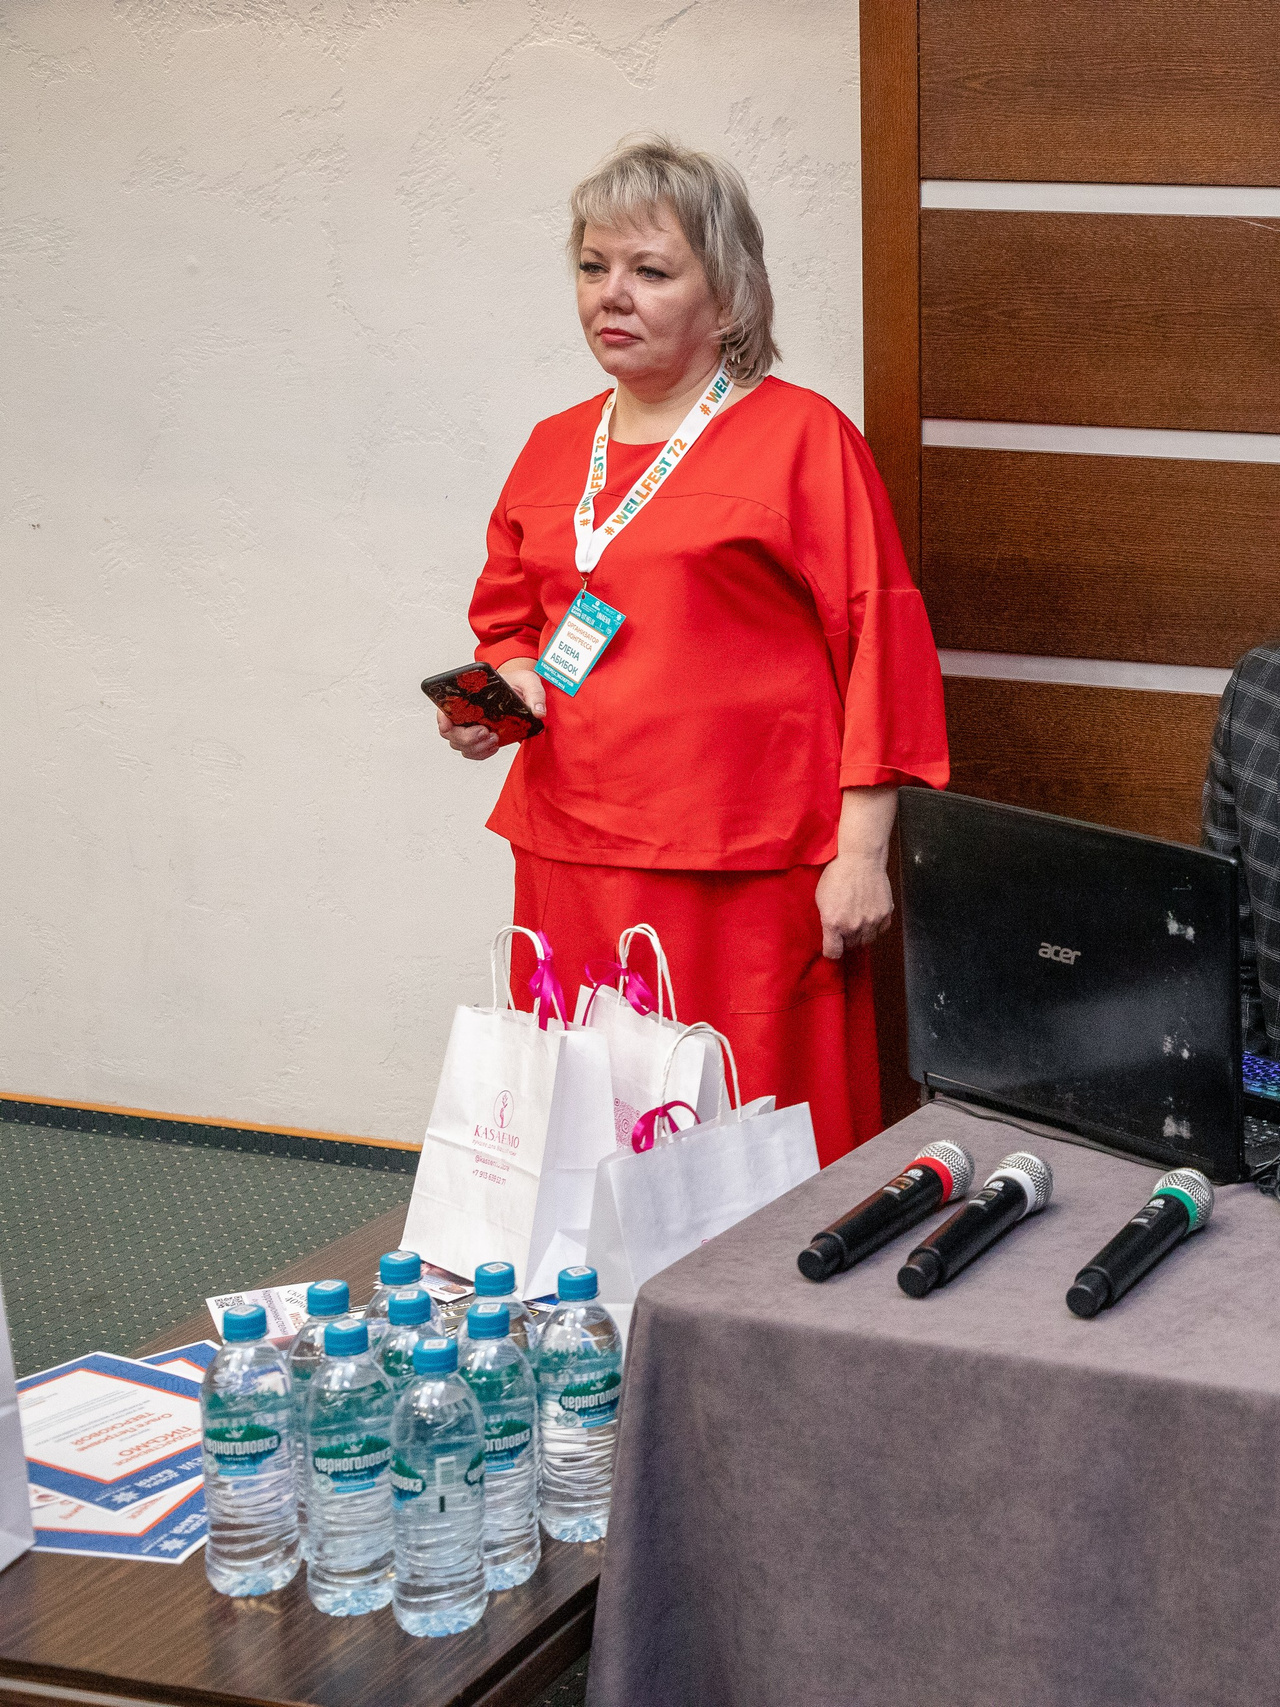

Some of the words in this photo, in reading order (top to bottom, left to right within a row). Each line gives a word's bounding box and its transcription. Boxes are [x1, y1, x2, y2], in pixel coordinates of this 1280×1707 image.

[611, 456, 673, 525] WELLFEST
[666, 438, 688, 458] 72
[566, 631, 593, 652] КОНГРЕССА
[567, 620, 600, 645] ОРГАНИЗАТОР
[558, 640, 580, 662] ЕЛЕНА
[550, 652, 579, 676] АБИБОК
[1038, 942, 1082, 965] acer
[473, 1124, 520, 1149] KASAEMO
[118, 1425, 193, 1457] ПИСЬМО
